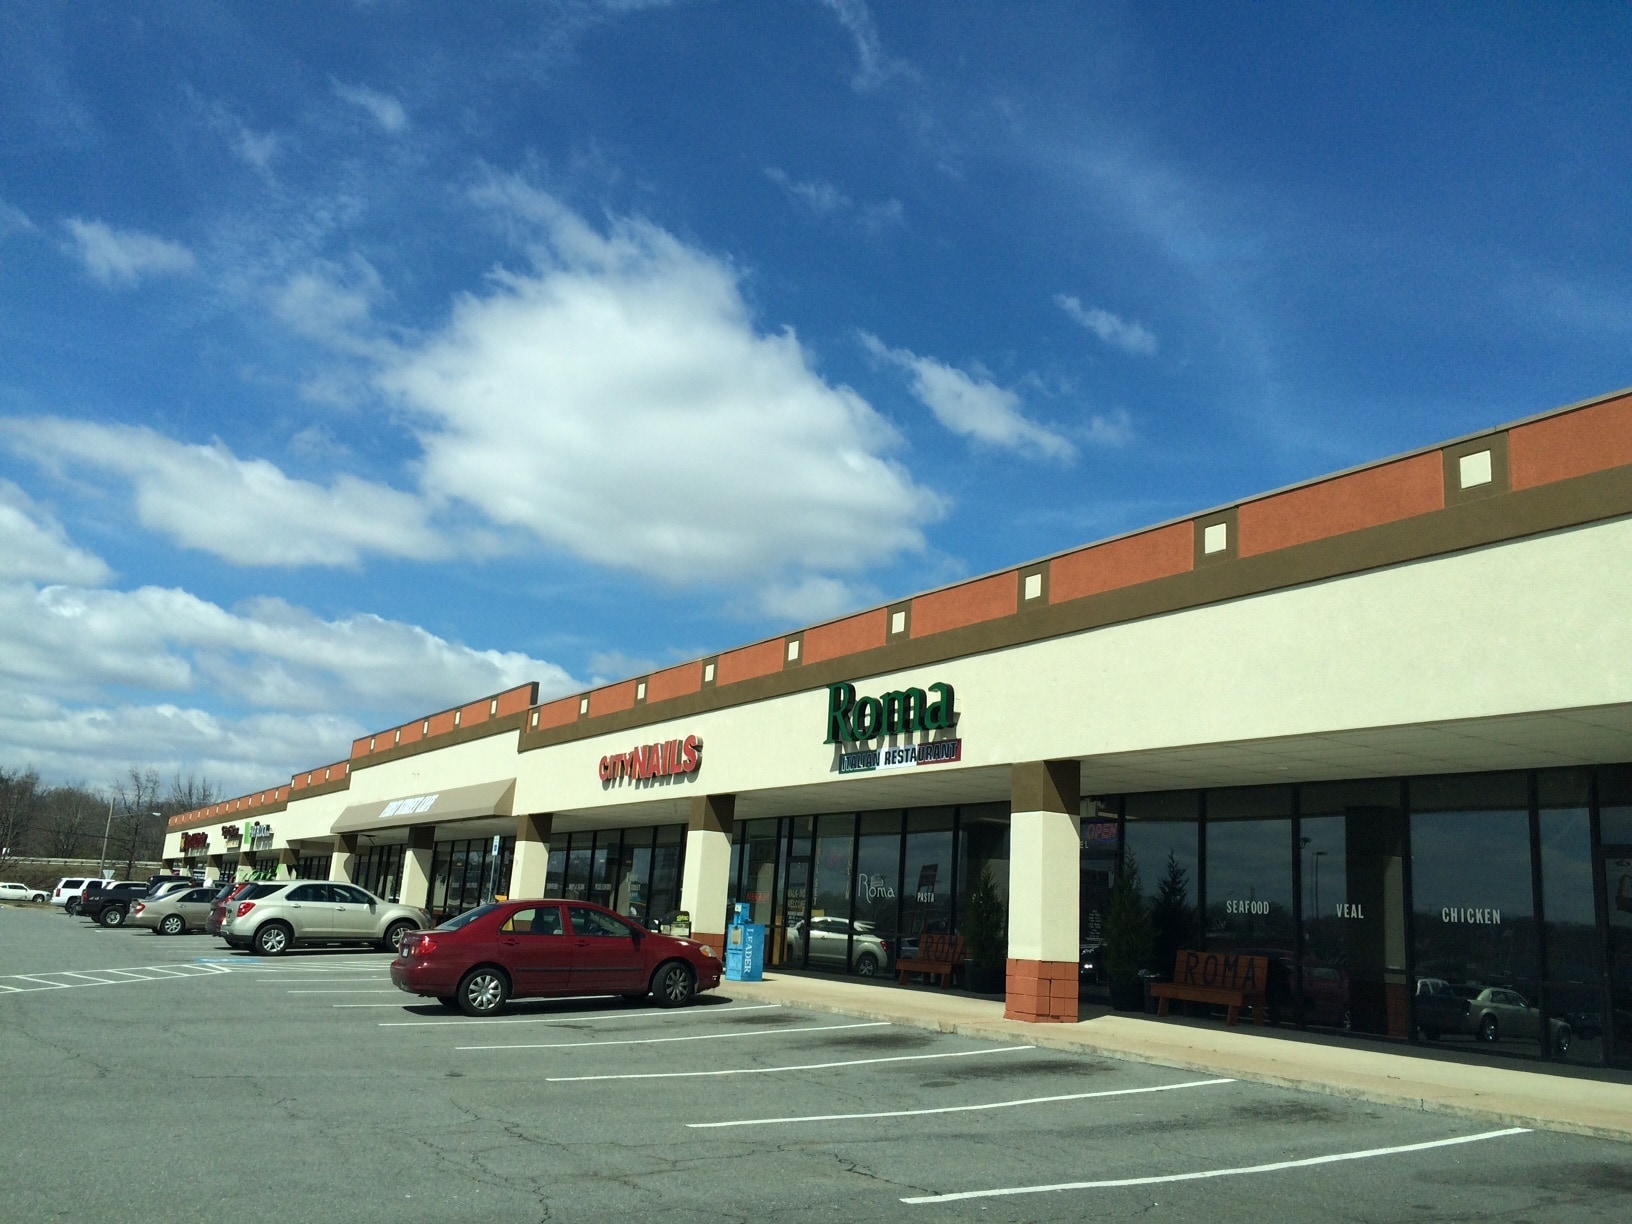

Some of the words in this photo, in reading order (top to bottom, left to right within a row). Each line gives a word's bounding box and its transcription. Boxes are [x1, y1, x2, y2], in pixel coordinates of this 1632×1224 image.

[823, 682, 955, 744] Roma
[841, 751, 880, 772] ITALIAN
[884, 741, 957, 766] RESTAURANT
[1087, 823, 1118, 840] OPEN
[858, 873, 895, 904] Roma
[917, 892, 935, 903] PASTA
[1226, 900, 1270, 915] SEAFOOD
[1336, 903, 1364, 919] VEAL
[1441, 907, 1501, 925] CHICKEN
[744, 928, 754, 974] LEADER
[1184, 951, 1256, 988] ROMA
